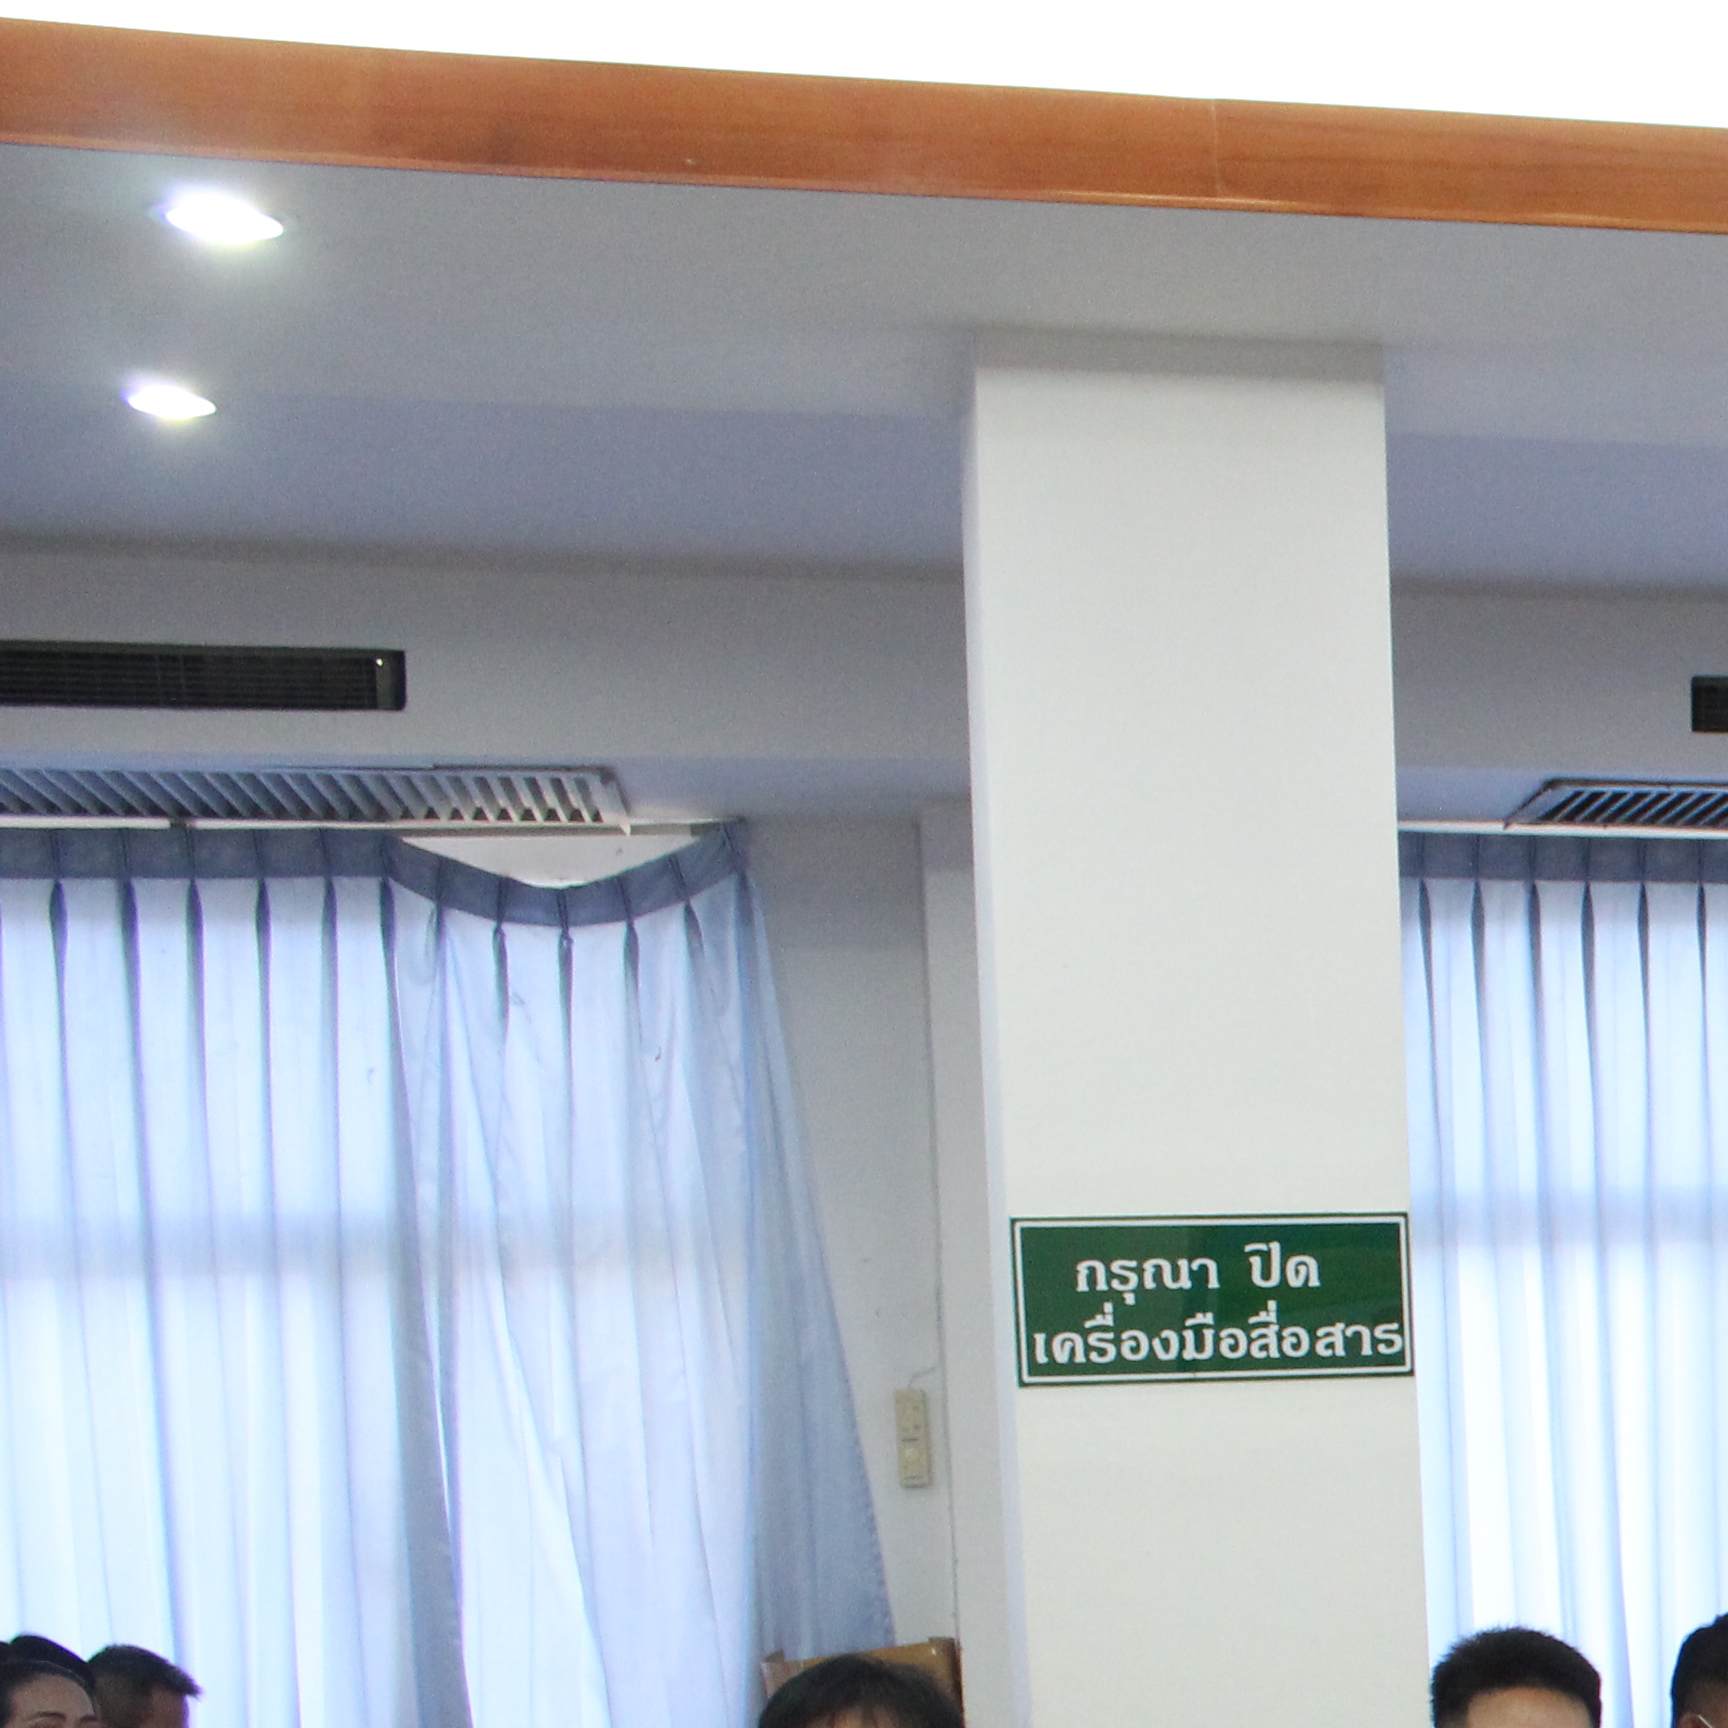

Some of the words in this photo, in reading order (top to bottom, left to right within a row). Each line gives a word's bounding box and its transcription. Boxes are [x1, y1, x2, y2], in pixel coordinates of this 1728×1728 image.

[1075, 1255, 1219, 1305] กรุณา
[1244, 1242, 1321, 1288] ปิด
[1033, 1301, 1405, 1364] เครื่องมือสื่อสาร
